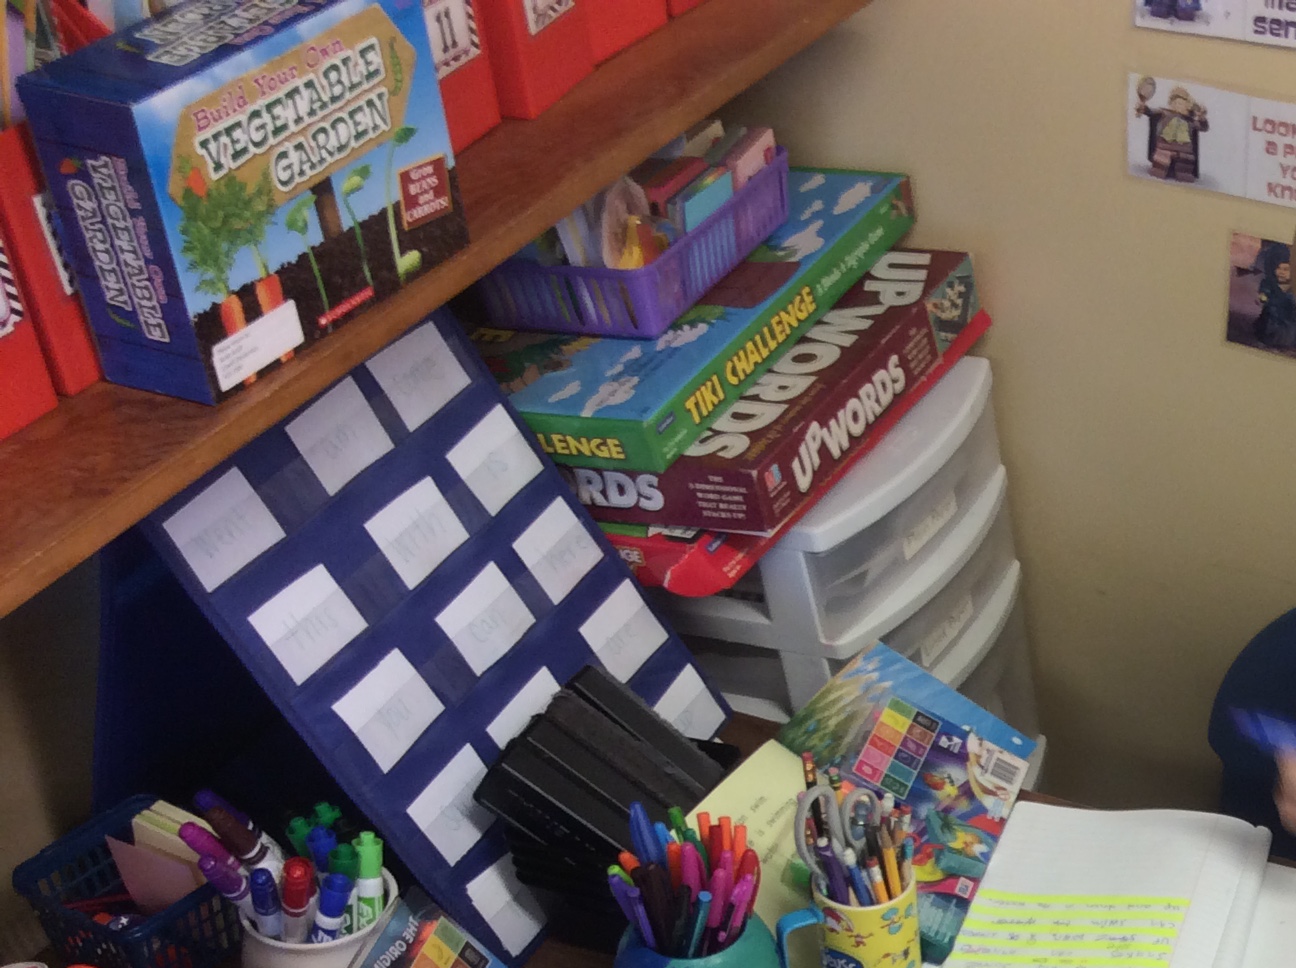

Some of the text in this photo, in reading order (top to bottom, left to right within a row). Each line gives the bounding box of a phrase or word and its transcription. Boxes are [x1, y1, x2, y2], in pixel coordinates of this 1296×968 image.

[191, 38, 345, 132] Build Your Own
[195, 36, 387, 181] VEGETABLE
[271, 86, 392, 192] GARDEN
[66, 179, 133, 312] GARDEN
[86, 154, 170, 343] VEGETABLE
[684, 378, 727, 427] TIKI
[724, 286, 818, 386] CHALLENGE
[539, 433, 626, 461] LENGE
[574, 468, 666, 512] RDS
[791, 353, 907, 494] UPWORDS
